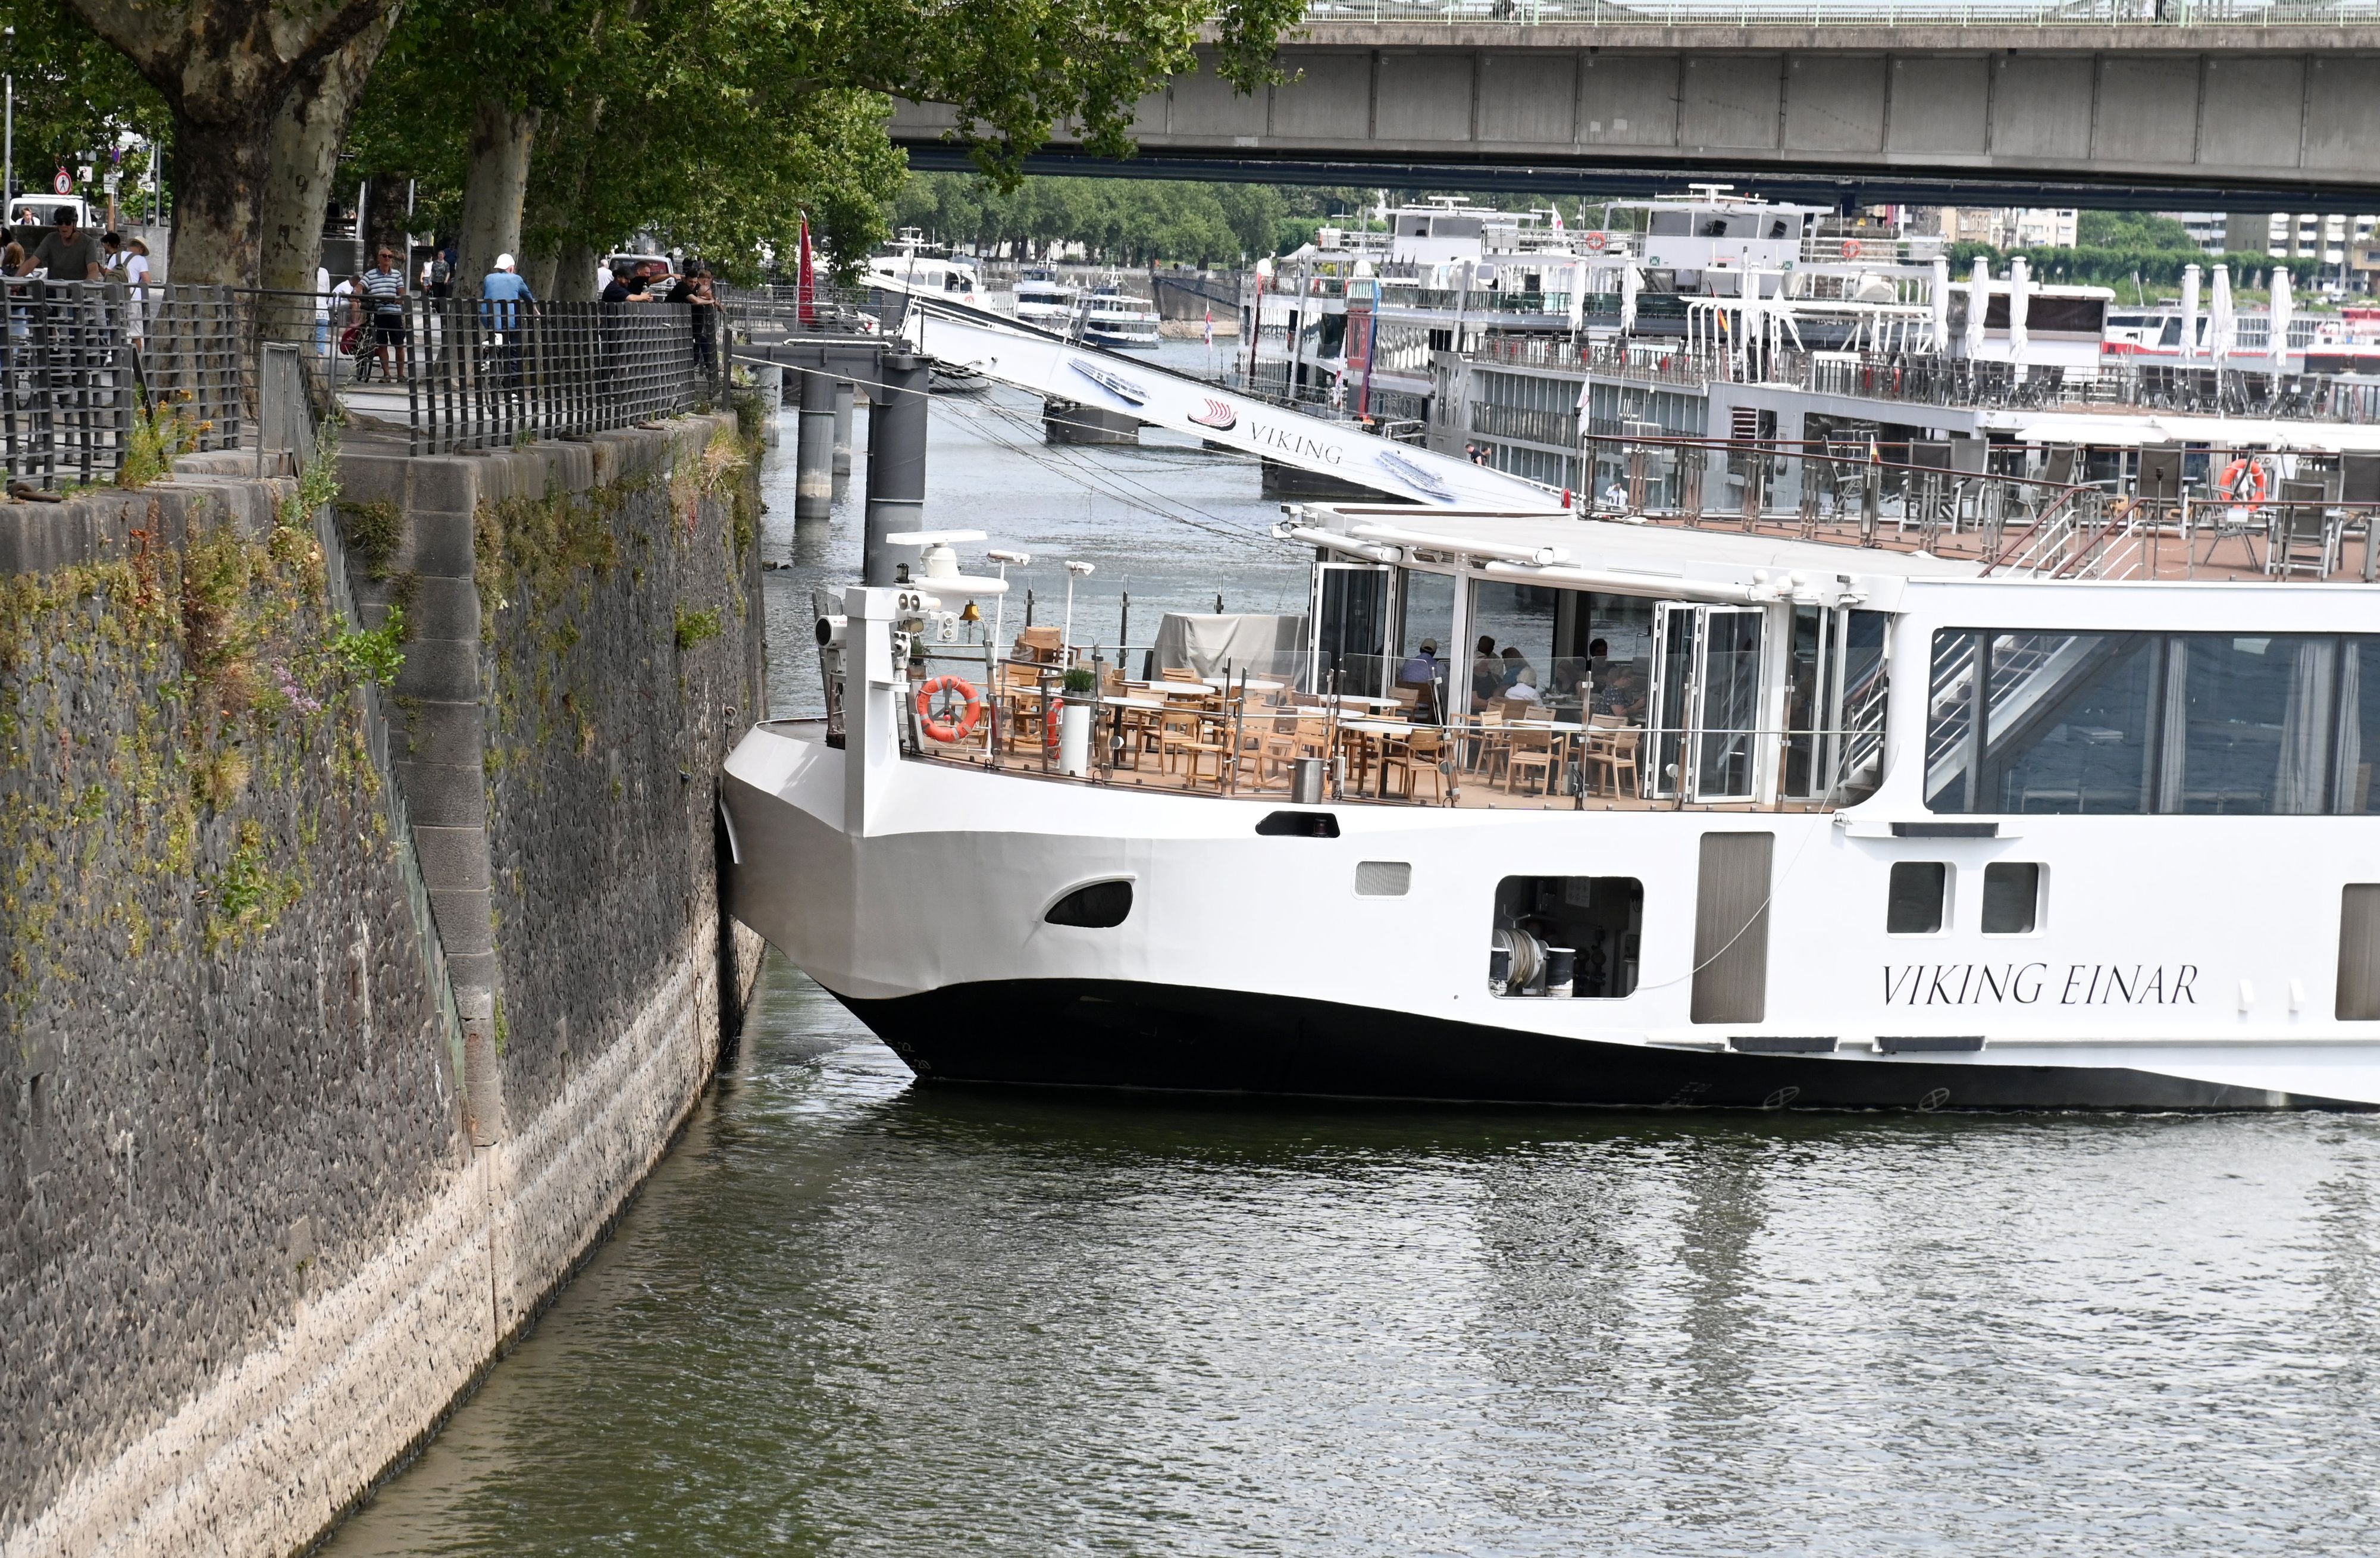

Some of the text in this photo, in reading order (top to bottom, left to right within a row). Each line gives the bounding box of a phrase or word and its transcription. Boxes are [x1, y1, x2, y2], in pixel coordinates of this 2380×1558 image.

[1251, 422, 1343, 464] VIKING
[1881, 962, 2199, 1006] VIKING EINAR
[913, 1059, 931, 1069] 20
